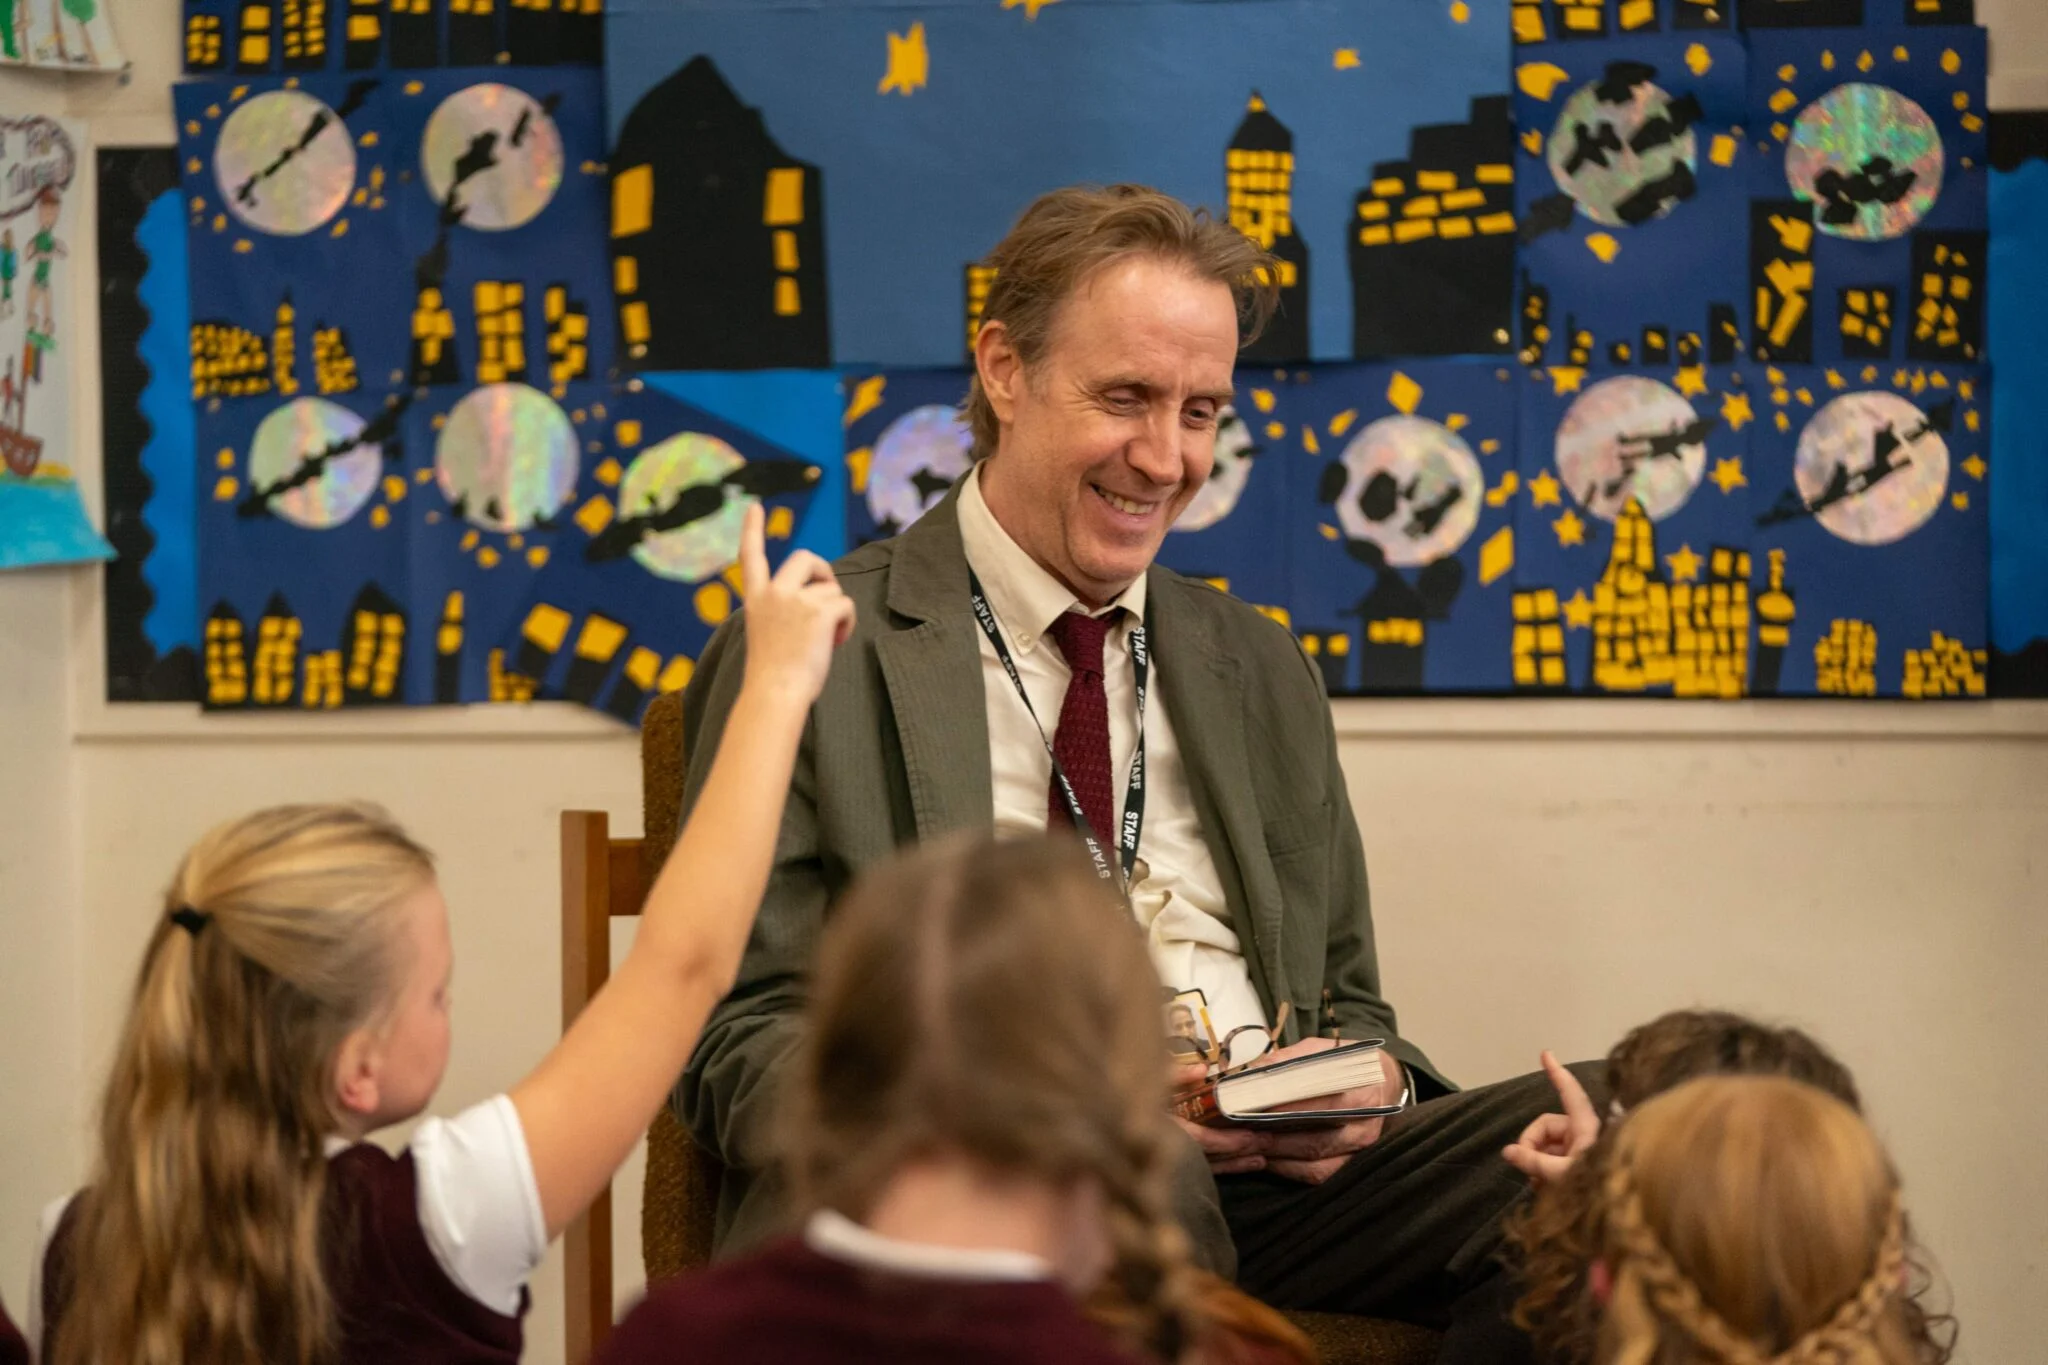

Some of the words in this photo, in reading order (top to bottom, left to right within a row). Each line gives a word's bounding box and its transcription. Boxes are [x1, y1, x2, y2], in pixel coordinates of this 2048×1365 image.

[972, 595, 995, 633] STAFF
[1133, 627, 1146, 666] STAFF
[1130, 750, 1142, 790] STAFF
[1123, 811, 1138, 850] STAFF
[1086, 837, 1111, 879] STAFF
